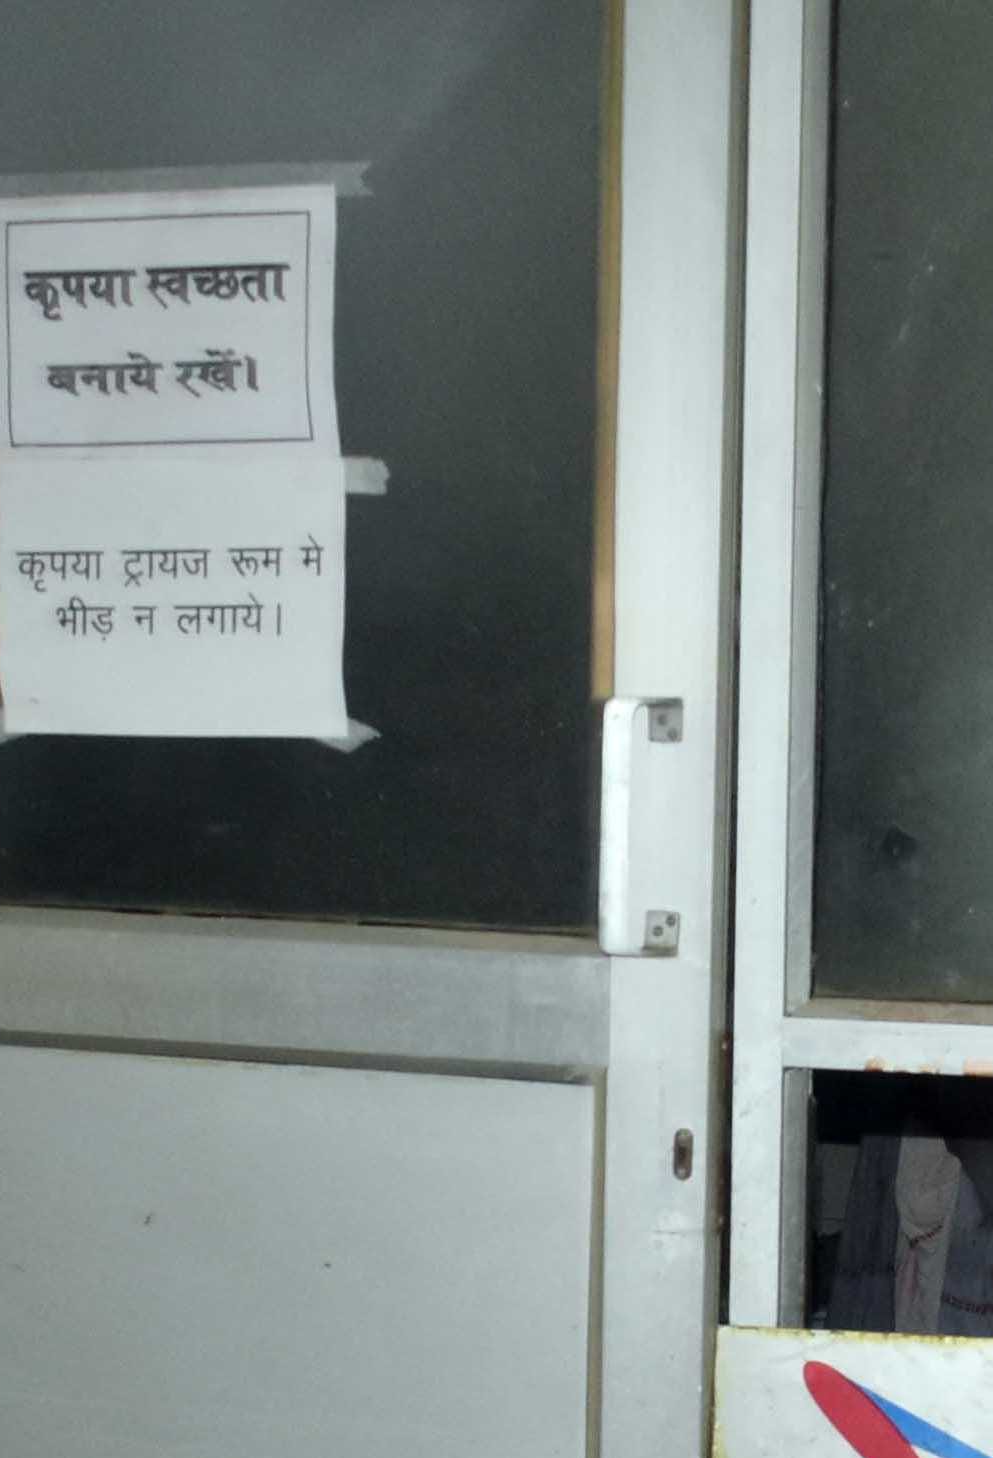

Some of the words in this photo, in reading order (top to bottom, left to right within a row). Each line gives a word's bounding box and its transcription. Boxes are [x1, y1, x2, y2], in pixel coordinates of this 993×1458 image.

[22, 269, 137, 321] कृपया
[145, 262, 291, 309] स्वच्छता
[45, 351, 163, 396] बनाये
[15, 549, 105, 593] कृपया
[120, 548, 211, 588] ट्रायज
[227, 546, 283, 577] रूम
[298, 533, 324, 577] मे
[55, 595, 116, 641] भीड़
[131, 605, 158, 635] न
